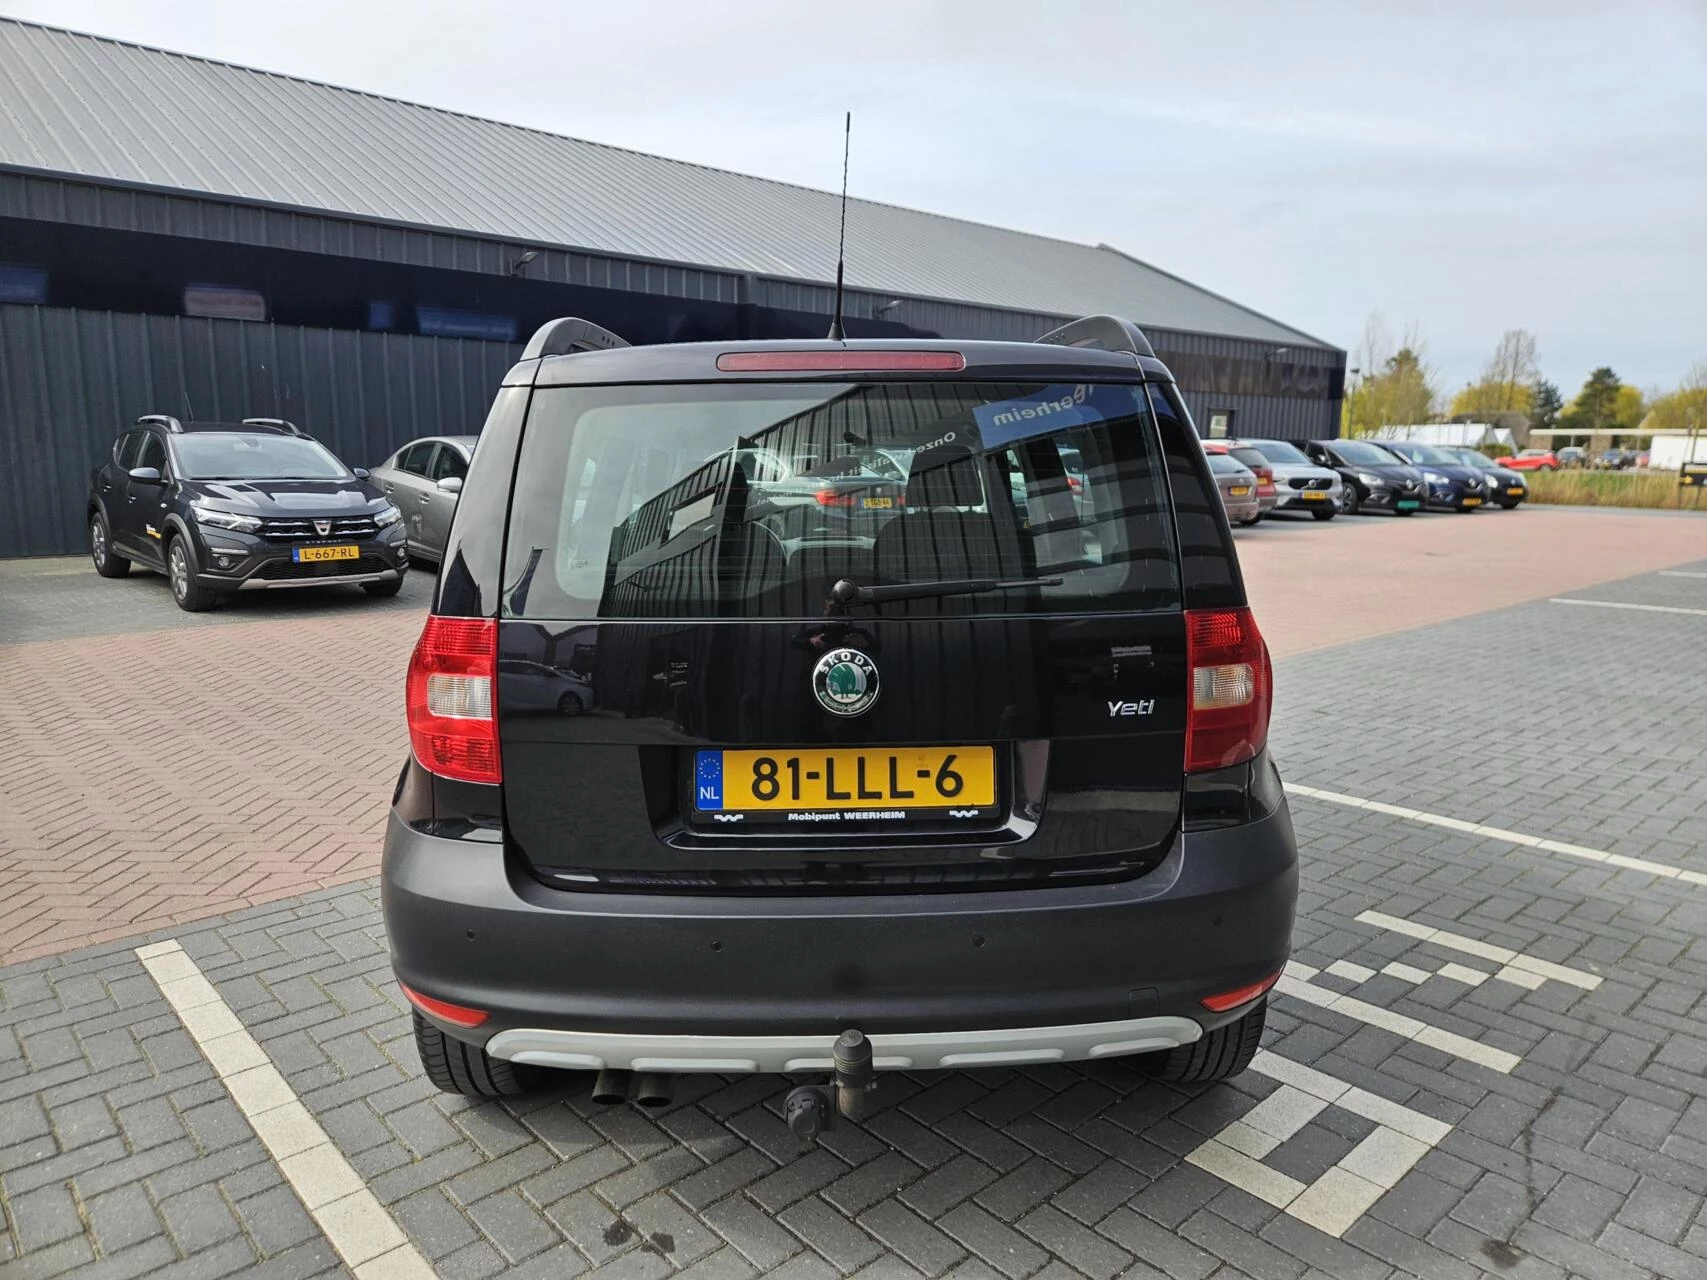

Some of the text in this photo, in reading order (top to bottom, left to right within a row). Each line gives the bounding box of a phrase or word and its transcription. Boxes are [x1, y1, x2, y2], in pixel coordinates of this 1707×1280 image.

[304, 548, 354, 560] L-667-RL
[1107, 699, 1155, 717] Yeti
[752, 754, 964, 801] 81-LLL-6
[700, 786, 719, 800] NL
[788, 811, 906, 822] Mobipunt WEERHEIM
